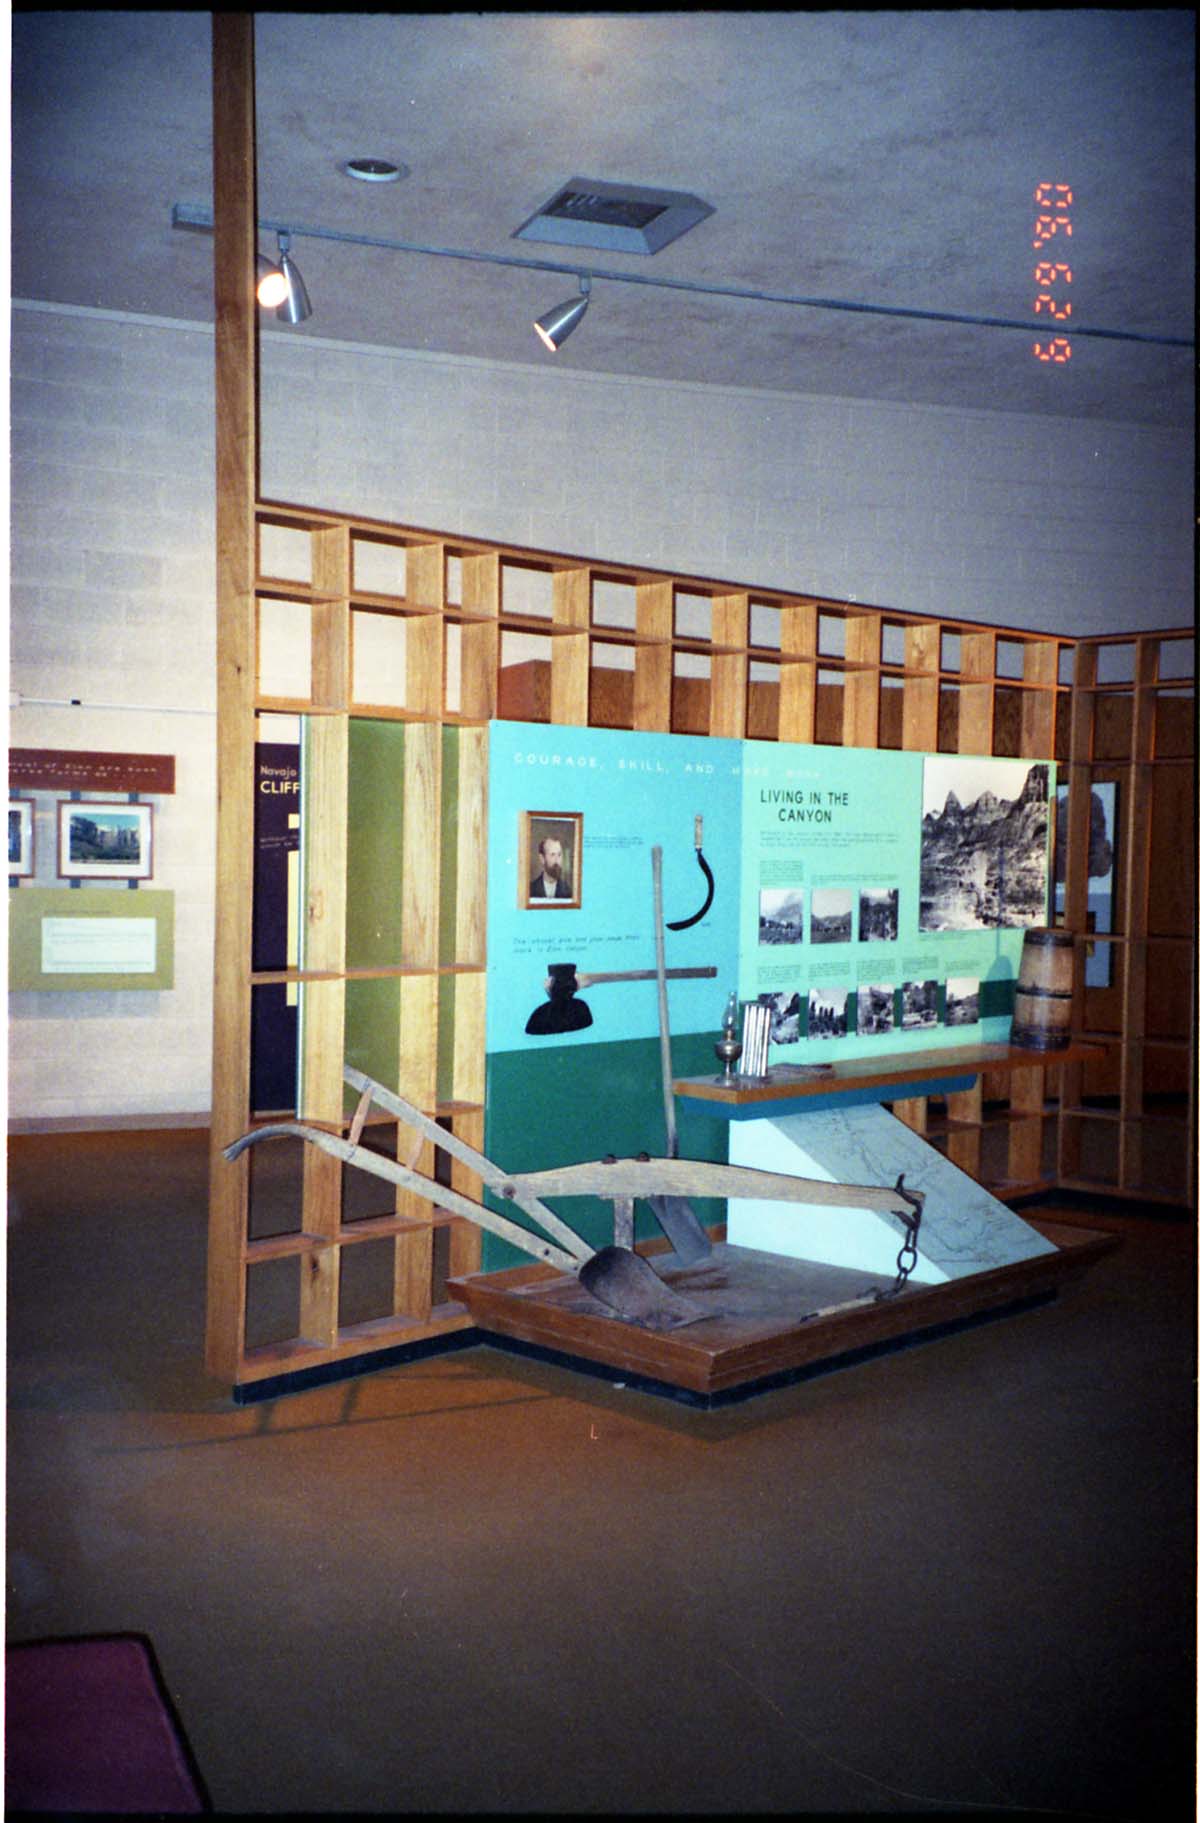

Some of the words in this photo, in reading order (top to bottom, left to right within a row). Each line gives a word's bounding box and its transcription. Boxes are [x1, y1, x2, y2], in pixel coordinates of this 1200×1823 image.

[260, 764, 297, 780] Navajo
[684, 763, 715, 775] AND
[260, 780, 300, 794] CLIFF
[760, 789, 804, 804] LIVING
[810, 791, 822, 805] IN
[828, 792, 849, 806] THE
[778, 808, 832, 823] CANYON
